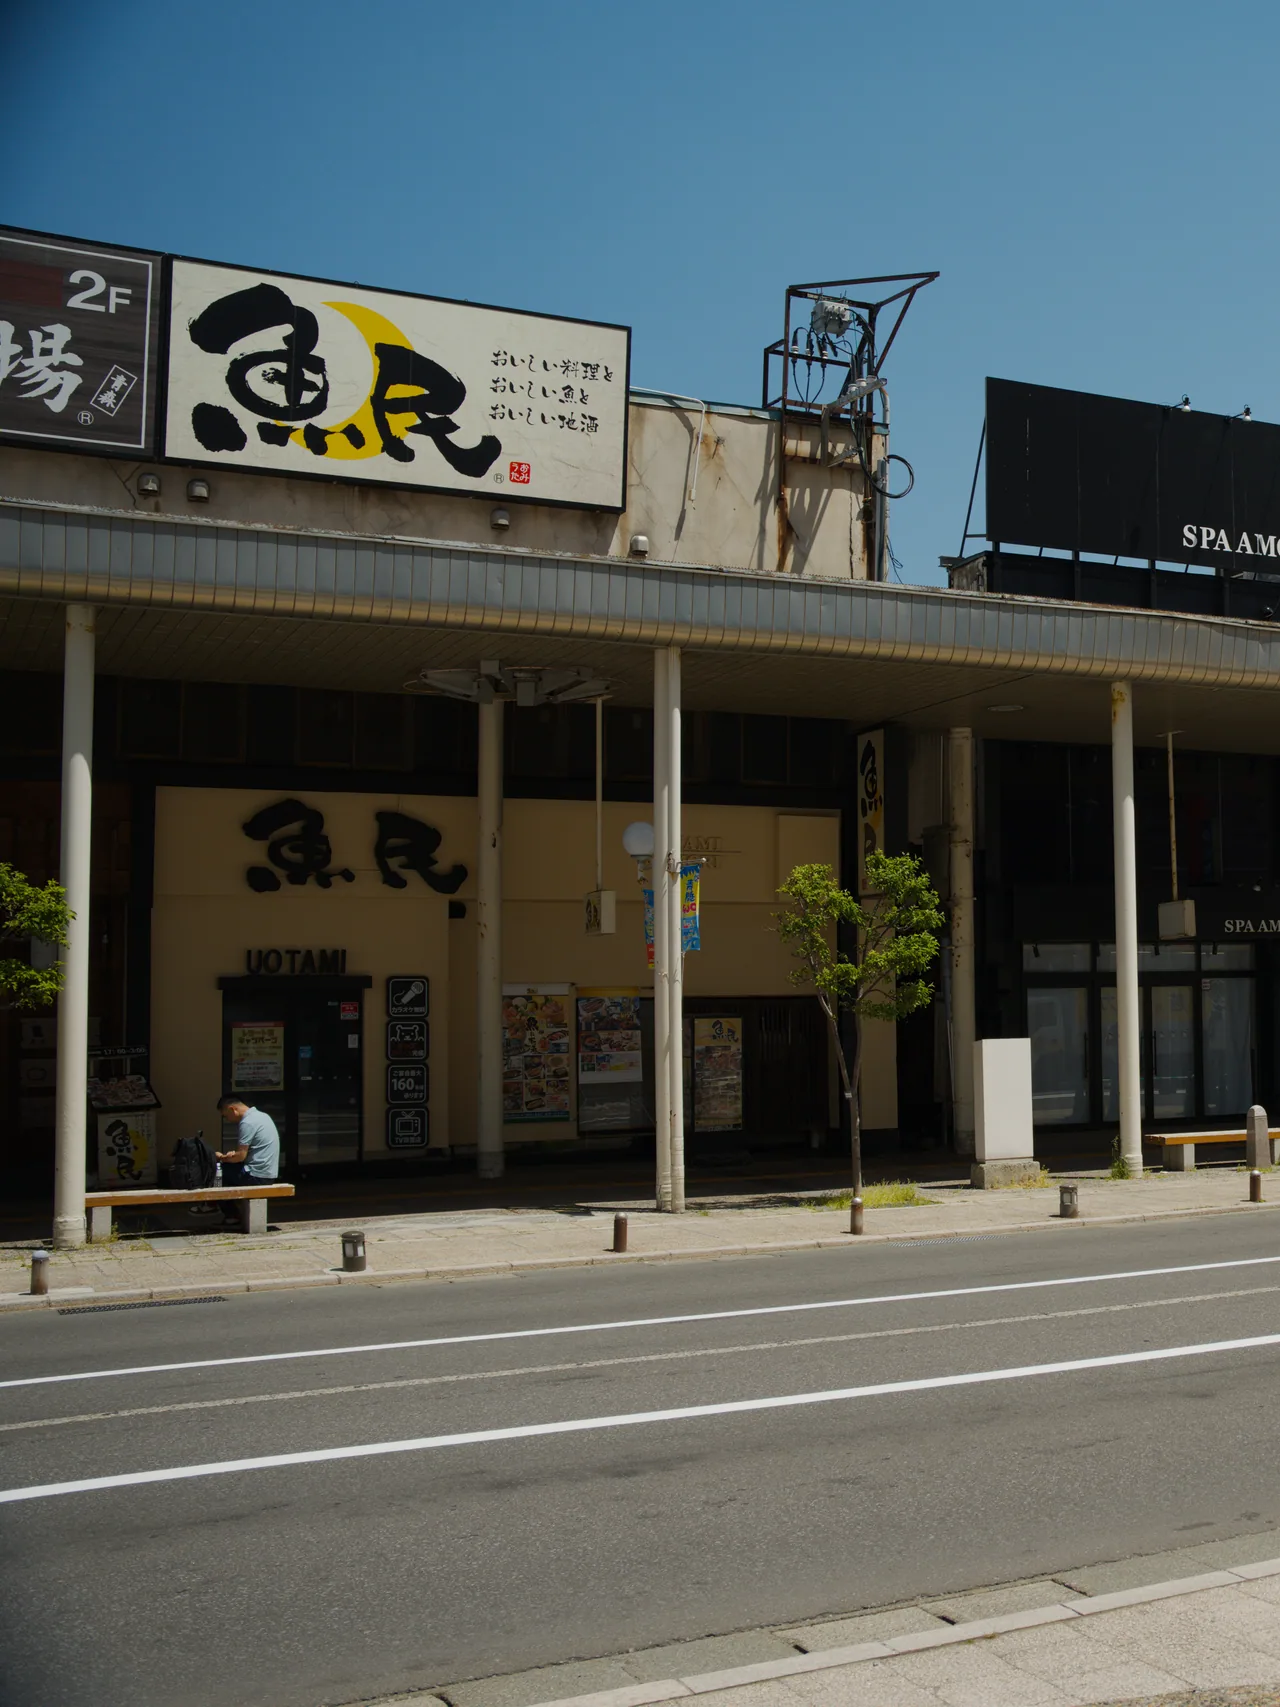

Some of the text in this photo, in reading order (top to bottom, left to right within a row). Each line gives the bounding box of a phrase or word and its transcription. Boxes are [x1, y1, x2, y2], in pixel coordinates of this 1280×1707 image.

[66, 269, 132, 314] 2F
[187, 282, 502, 478] 魚民
[491, 350, 614, 382] おいしい料理と
[97, 374, 128, 408] 青森
[489, 377, 590, 405] おいしい魚と
[488, 403, 600, 433] おいしい地酒
[1182, 523, 1231, 552] SPA
[241, 798, 469, 894] 魚民
[1224, 919, 1254, 933] SPA
[246, 949, 347, 976] UOTAMI
[391, 1077, 415, 1091] 160
[105, 1119, 144, 1181] 魚民
